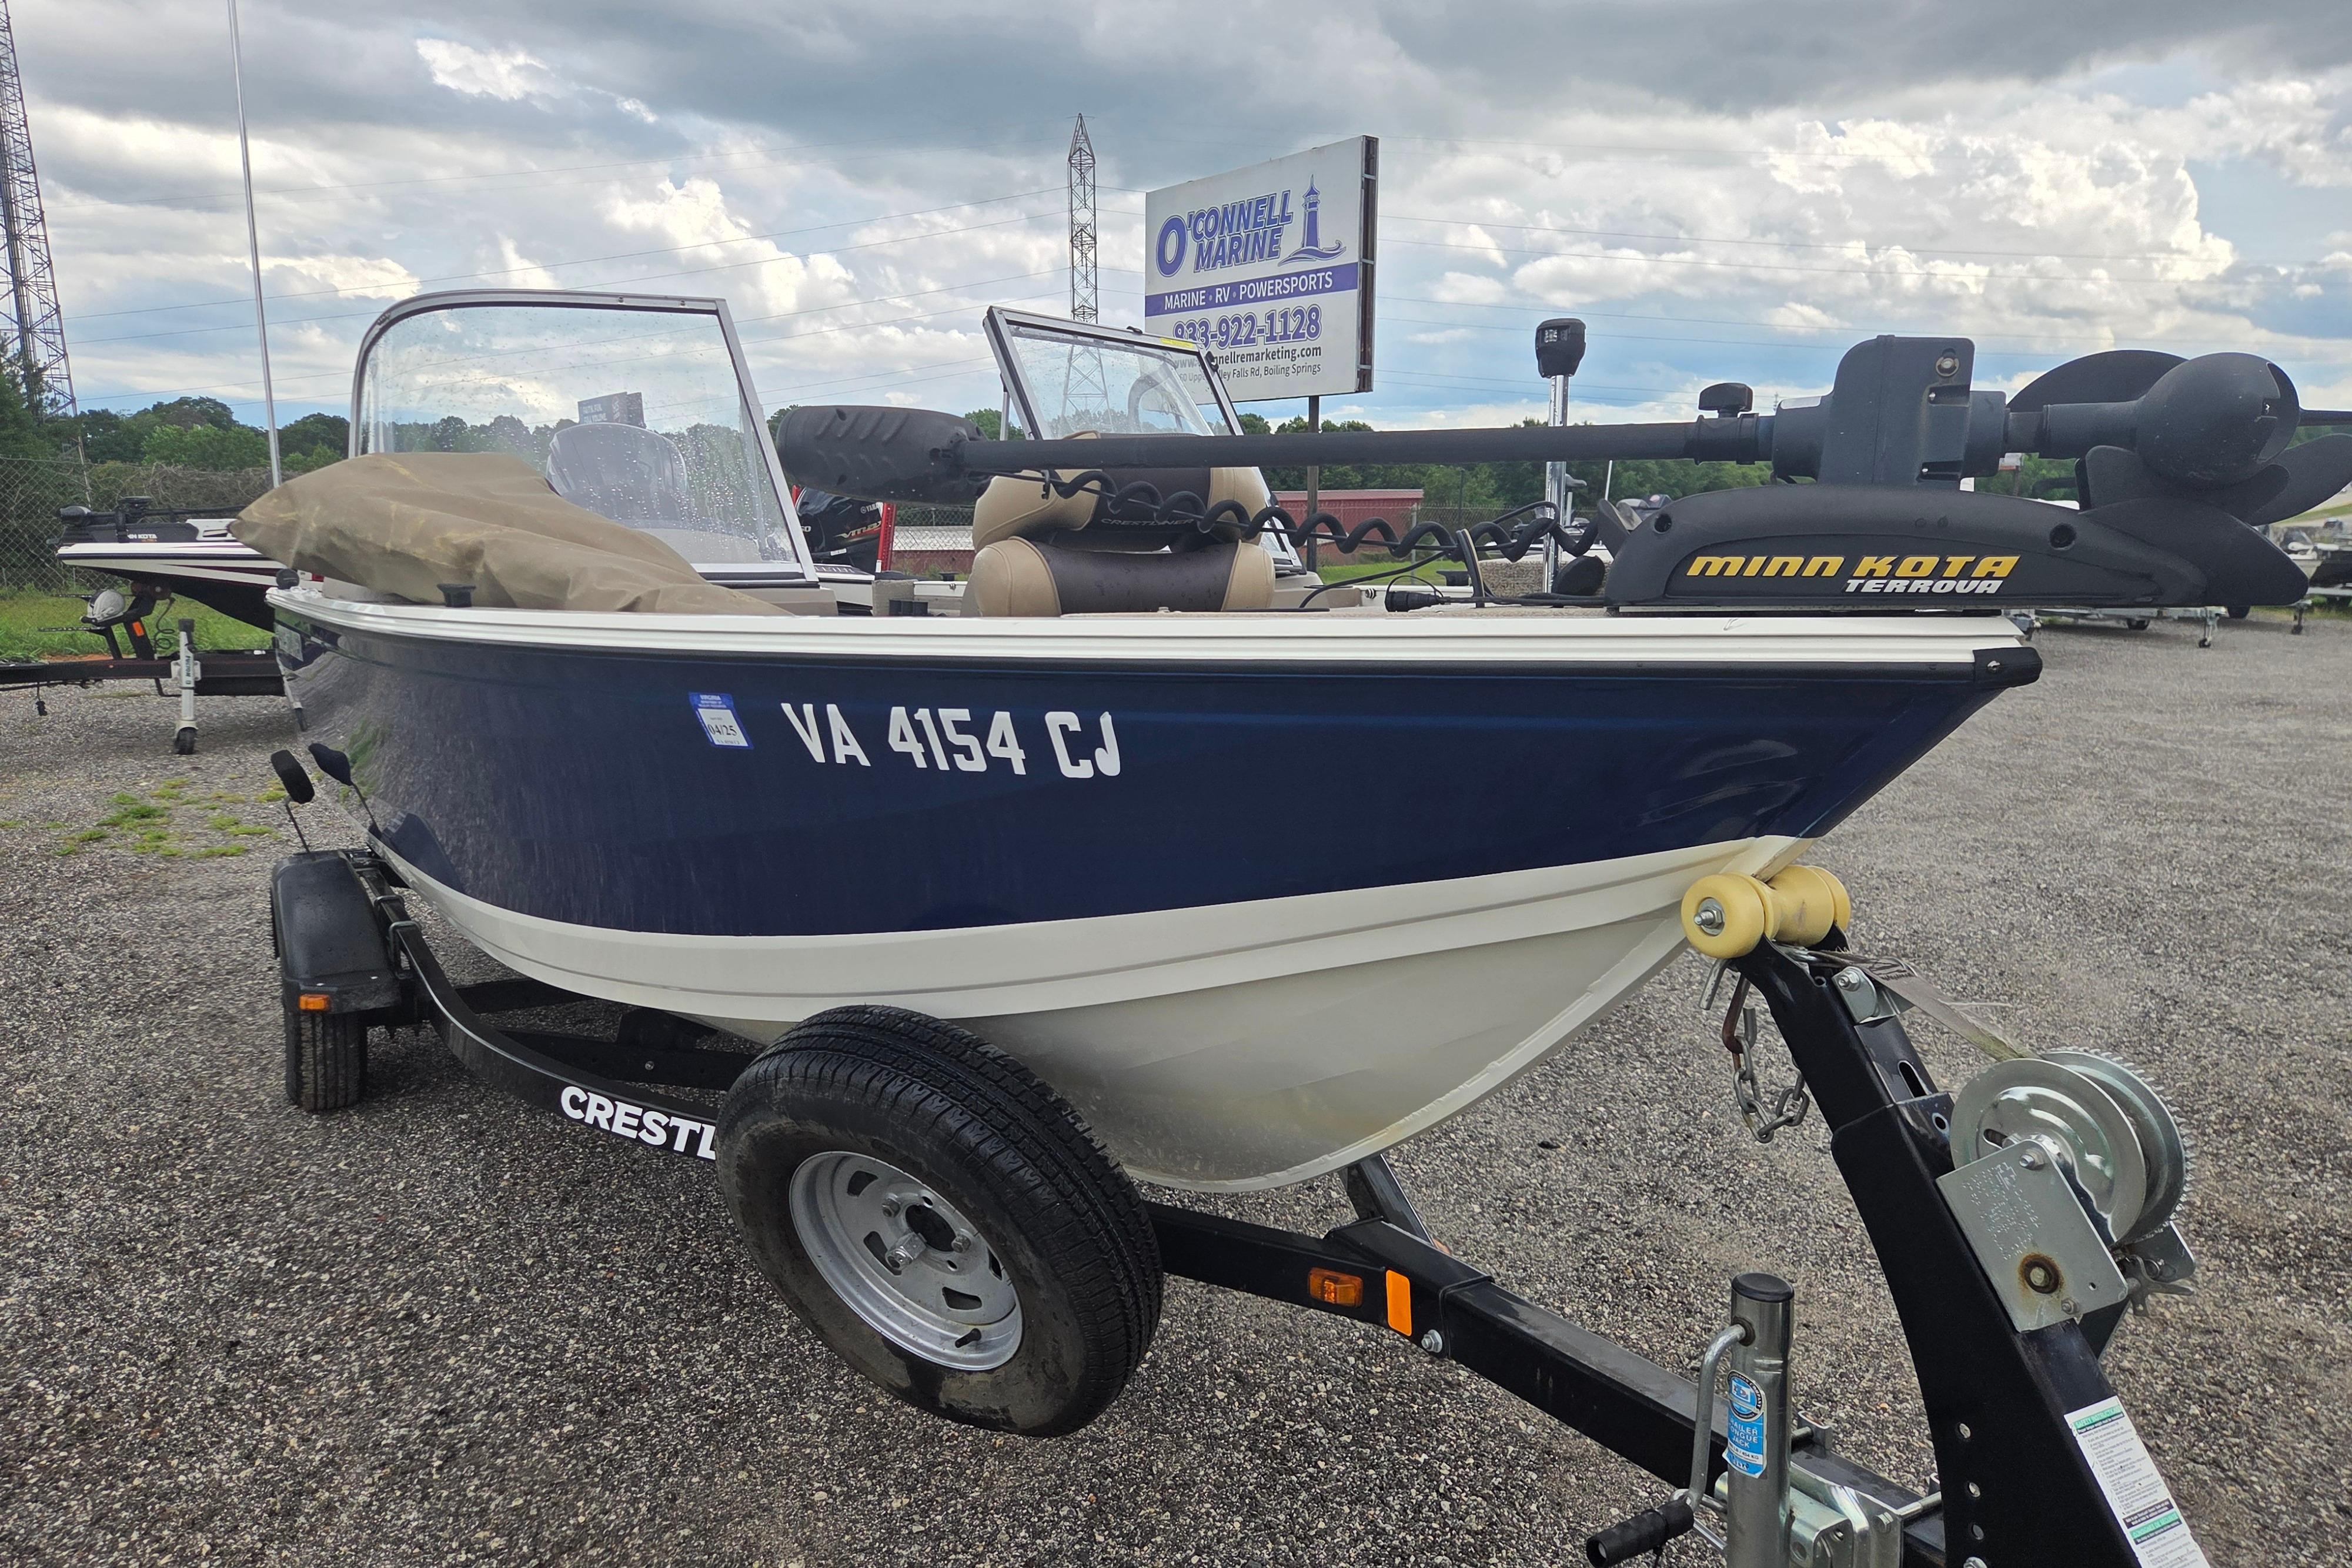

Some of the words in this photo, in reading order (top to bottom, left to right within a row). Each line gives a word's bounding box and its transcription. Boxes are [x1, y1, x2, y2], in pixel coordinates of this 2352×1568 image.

[1156, 189, 1294, 277] O'CONNELL
[1194, 226, 1283, 273] MARINE
[1164, 290, 1206, 310] MARINE
[1215, 286, 1231, 303] RV
[1240, 272, 1333, 299] POWERSPORTS
[1173, 304, 1322, 350] 833-922-1128
[1232, 368, 1249, 379] Falls
[1250, 366, 1262, 378] Rd,
[1264, 365, 1290, 377] Boiling
[1292, 362, 1321, 376] Springs
[1685, 556, 1845, 577] MINN
[1852, 554, 2021, 577] KOTA
[1845, 579, 2003, 594] TERROVA
[707, 724, 737, 736] 04/25
[781, 703, 871, 767] VA
[888, 706, 1027, 775] 4154
[1044, 711, 1121, 778] CJ
[561, 1086, 717, 1161] CRESTL
[1729, 1425, 1758, 1444] ONGUE
[1730, 1417, 1758, 1436] RAILER
[1732, 1435, 1750, 1449] JACK
